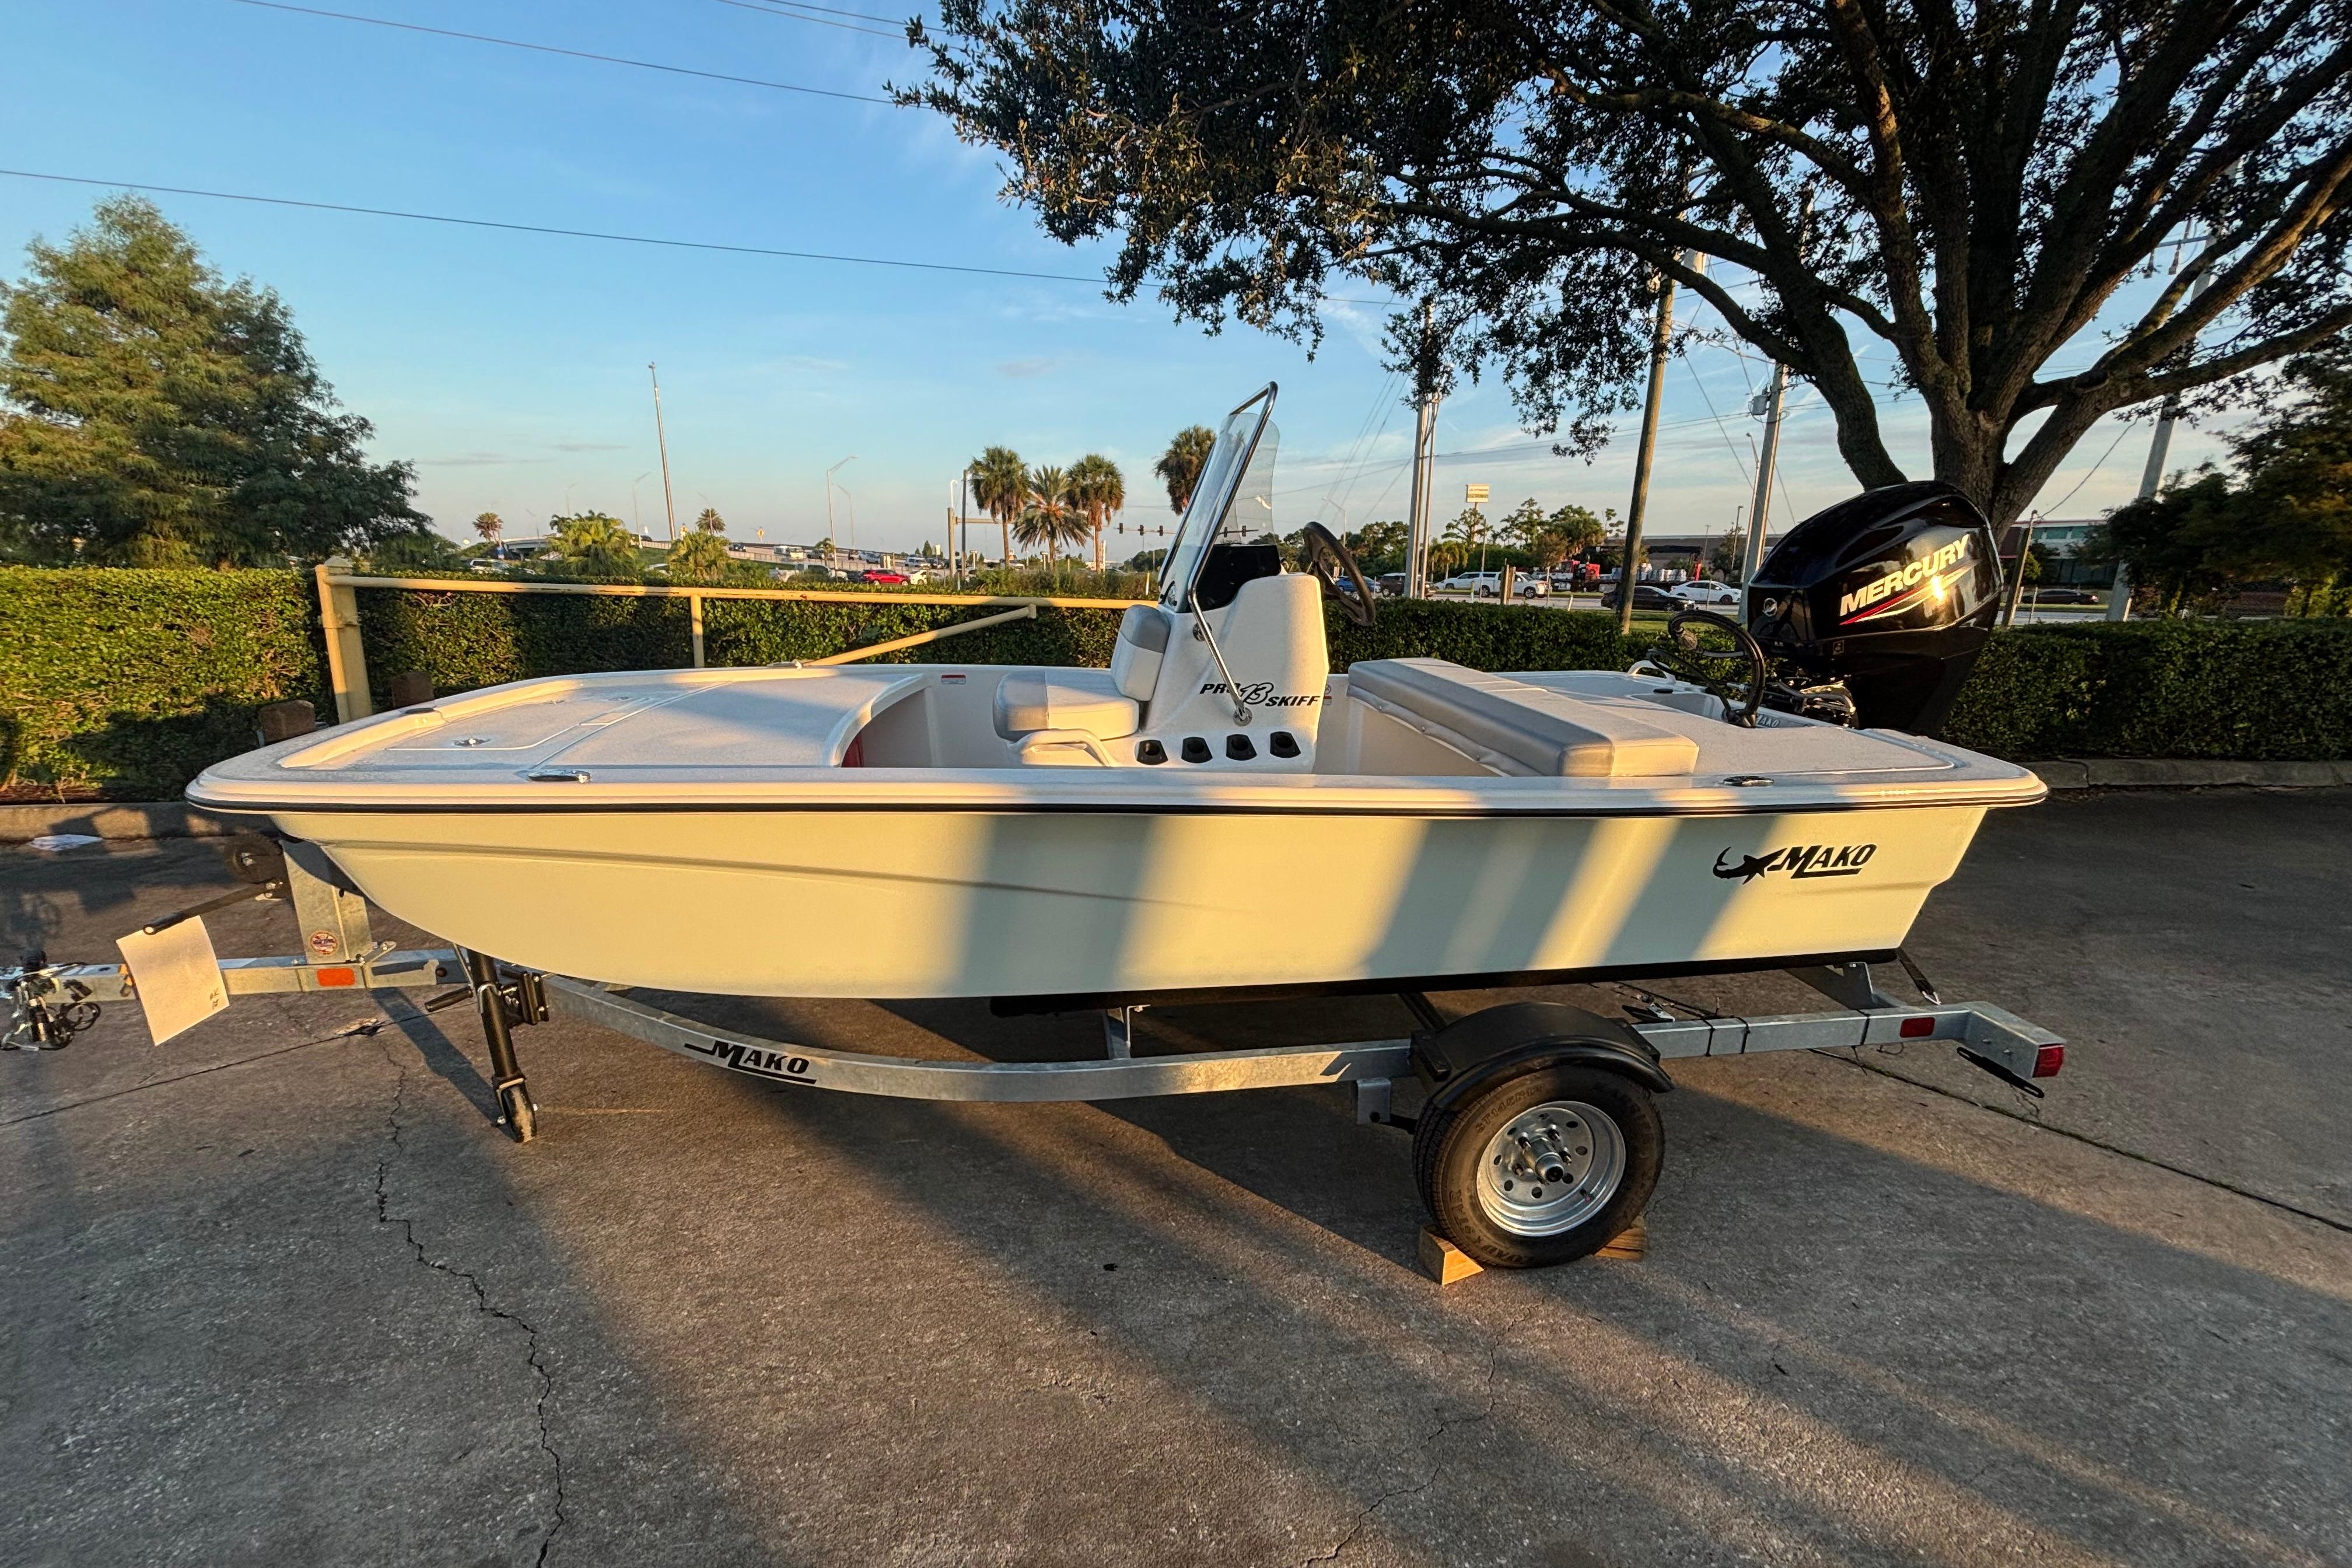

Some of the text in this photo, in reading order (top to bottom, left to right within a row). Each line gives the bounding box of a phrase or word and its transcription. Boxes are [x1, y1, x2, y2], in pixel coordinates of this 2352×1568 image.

[1840, 534, 1970, 617] MERCURY
[1240, 682, 1275, 705] 13
[1265, 695, 1321, 707] SKIFF
[1767, 844, 1877, 879] MAKO
[684, 1040, 817, 1084] MAKO
